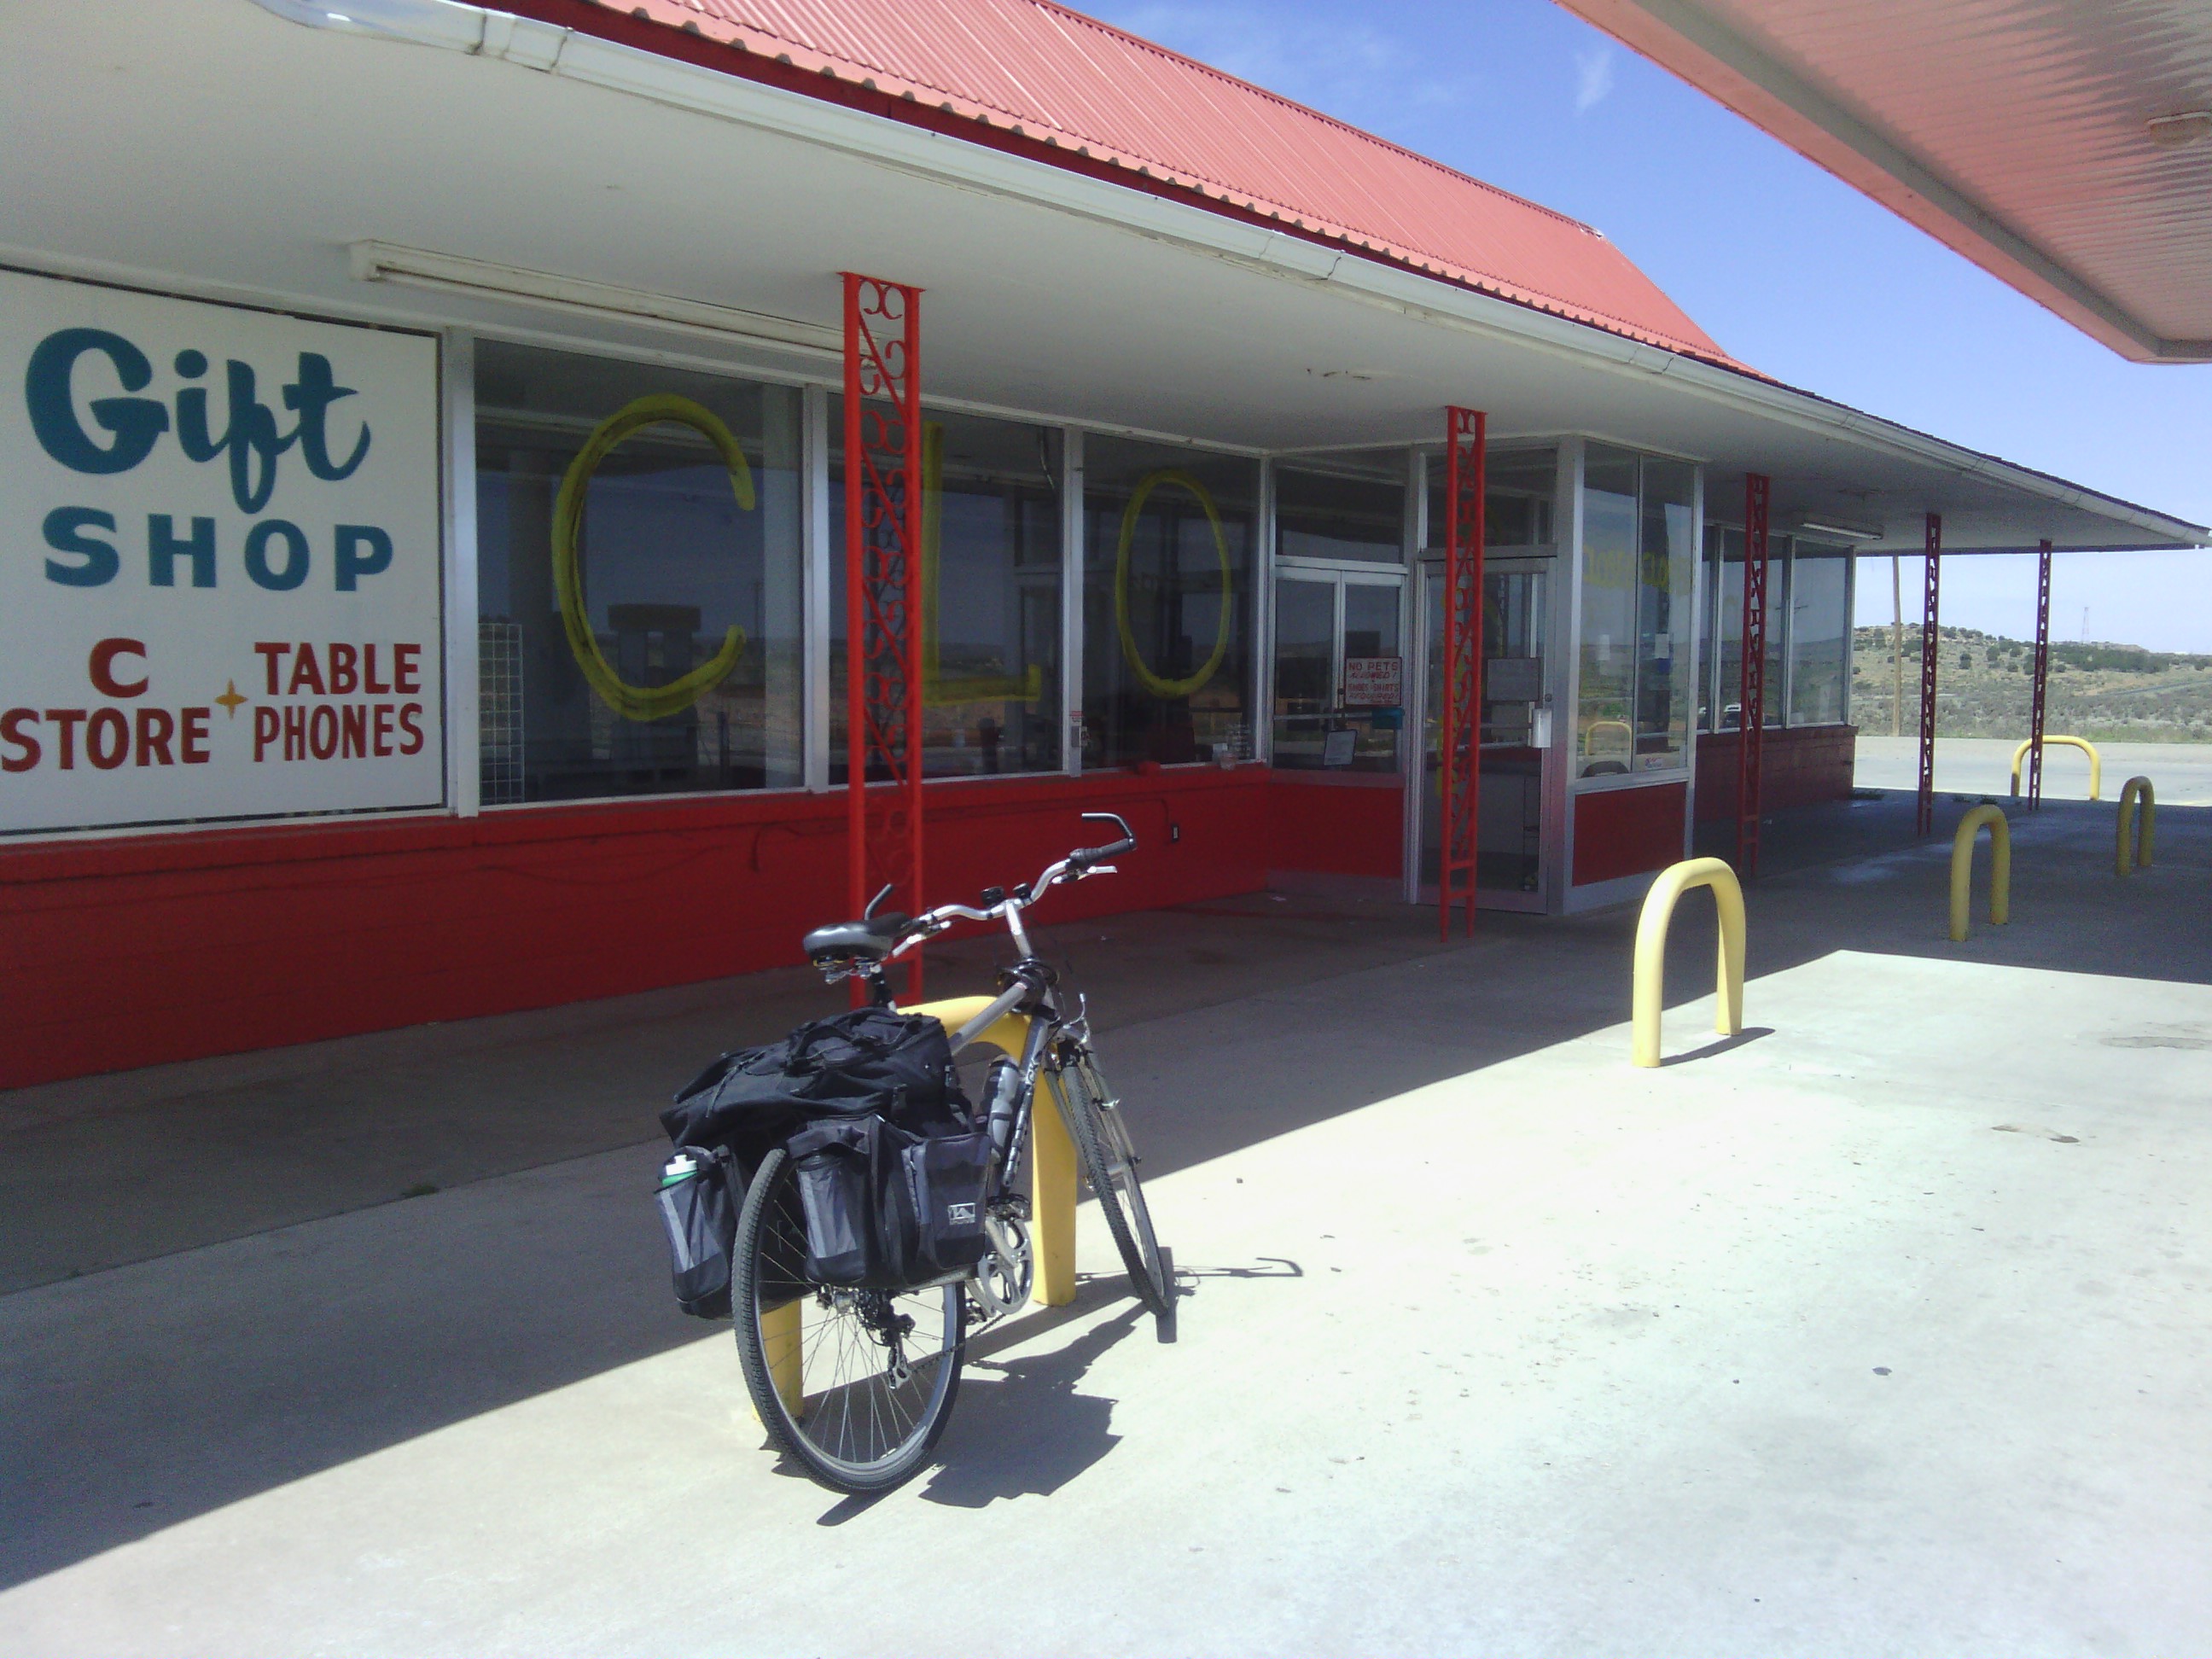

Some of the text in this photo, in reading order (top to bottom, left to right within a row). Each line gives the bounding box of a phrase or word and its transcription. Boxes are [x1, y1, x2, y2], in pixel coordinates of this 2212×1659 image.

[25, 328, 370, 514] Gift
[43, 506, 393, 591] SHOP
[89, 637, 149, 697] C
[254, 642, 422, 696] TABLE
[1348, 661, 1399, 671] NO PETS
[0, 707, 211, 772] STORE
[253, 702, 425, 762] PHONES
